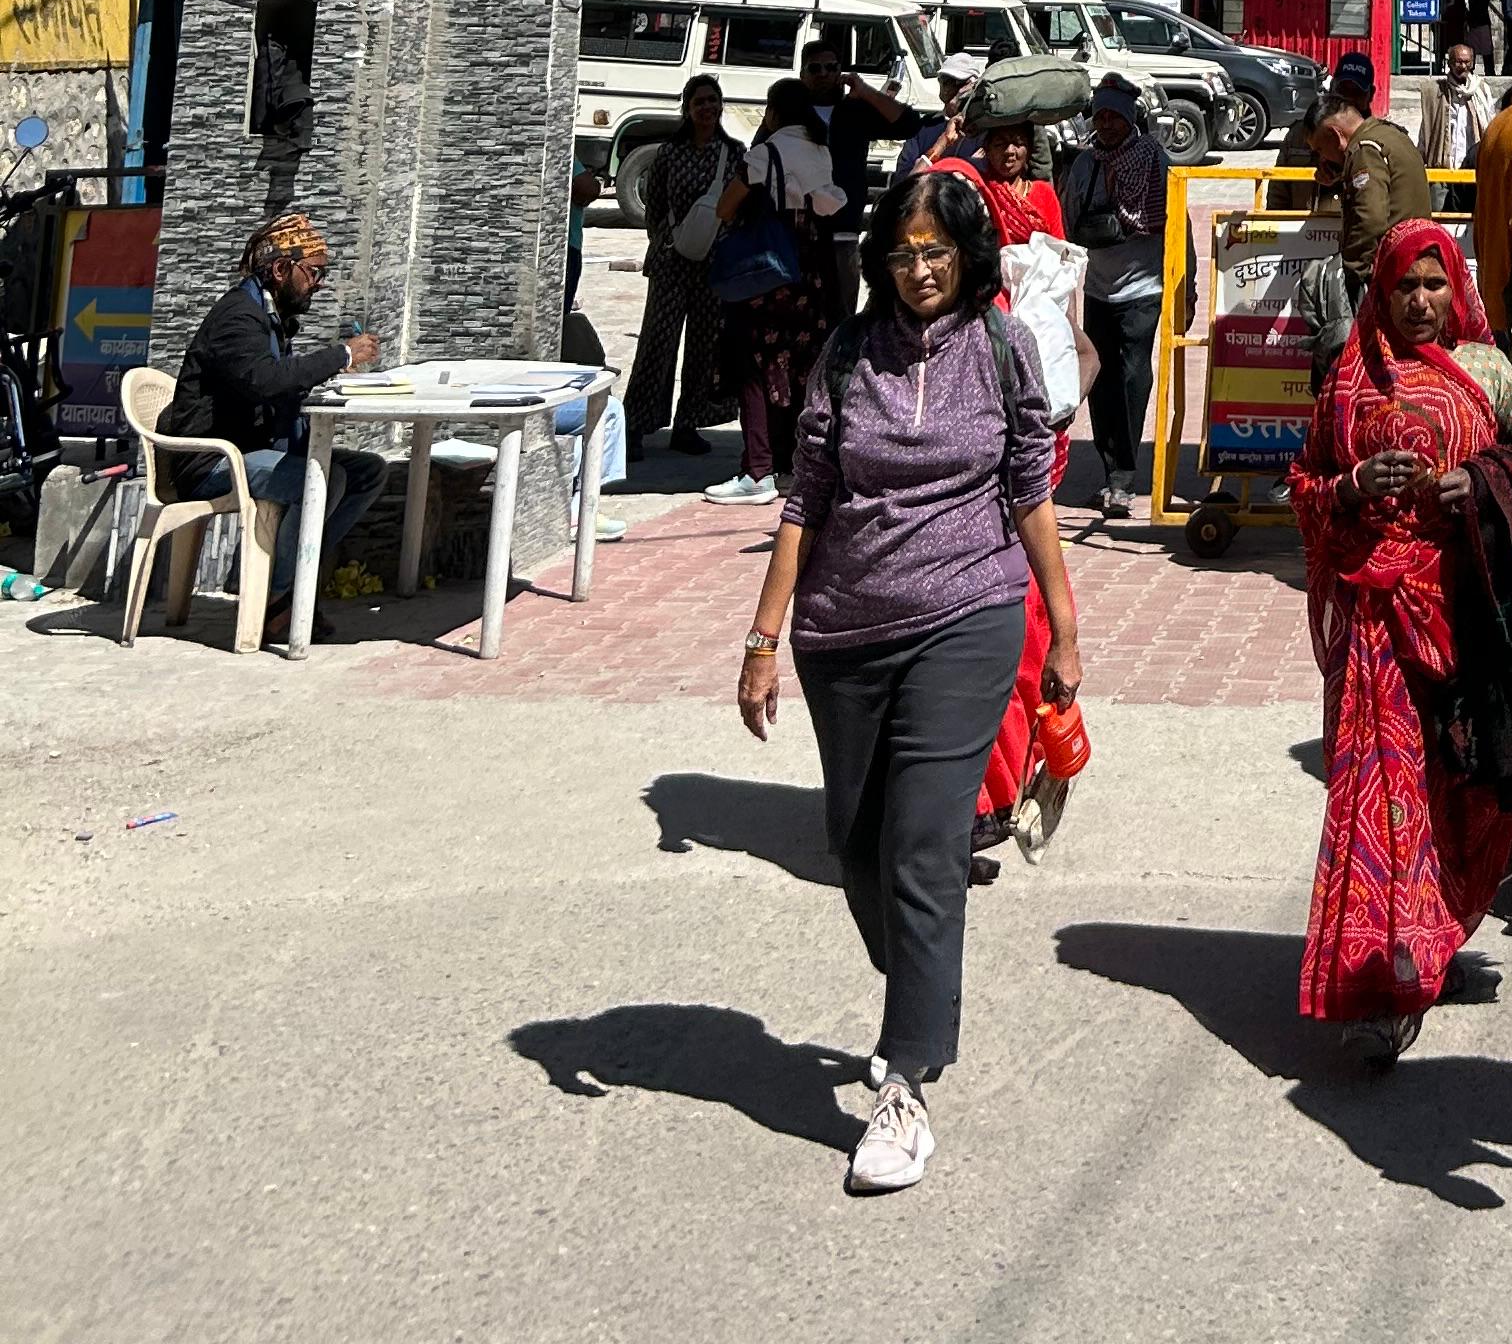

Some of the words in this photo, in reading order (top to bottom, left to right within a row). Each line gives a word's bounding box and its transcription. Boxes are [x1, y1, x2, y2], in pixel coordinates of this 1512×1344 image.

[1233, 255, 1304, 288] दुर्घटनाग्र
[1225, 329, 1263, 345] पंजाब
[1265, 327, 1302, 347] नैशन
[61, 404, 118, 425] यातायात
[1226, 413, 1312, 439] उत्तर
[1278, 451, 1295, 462] 112
